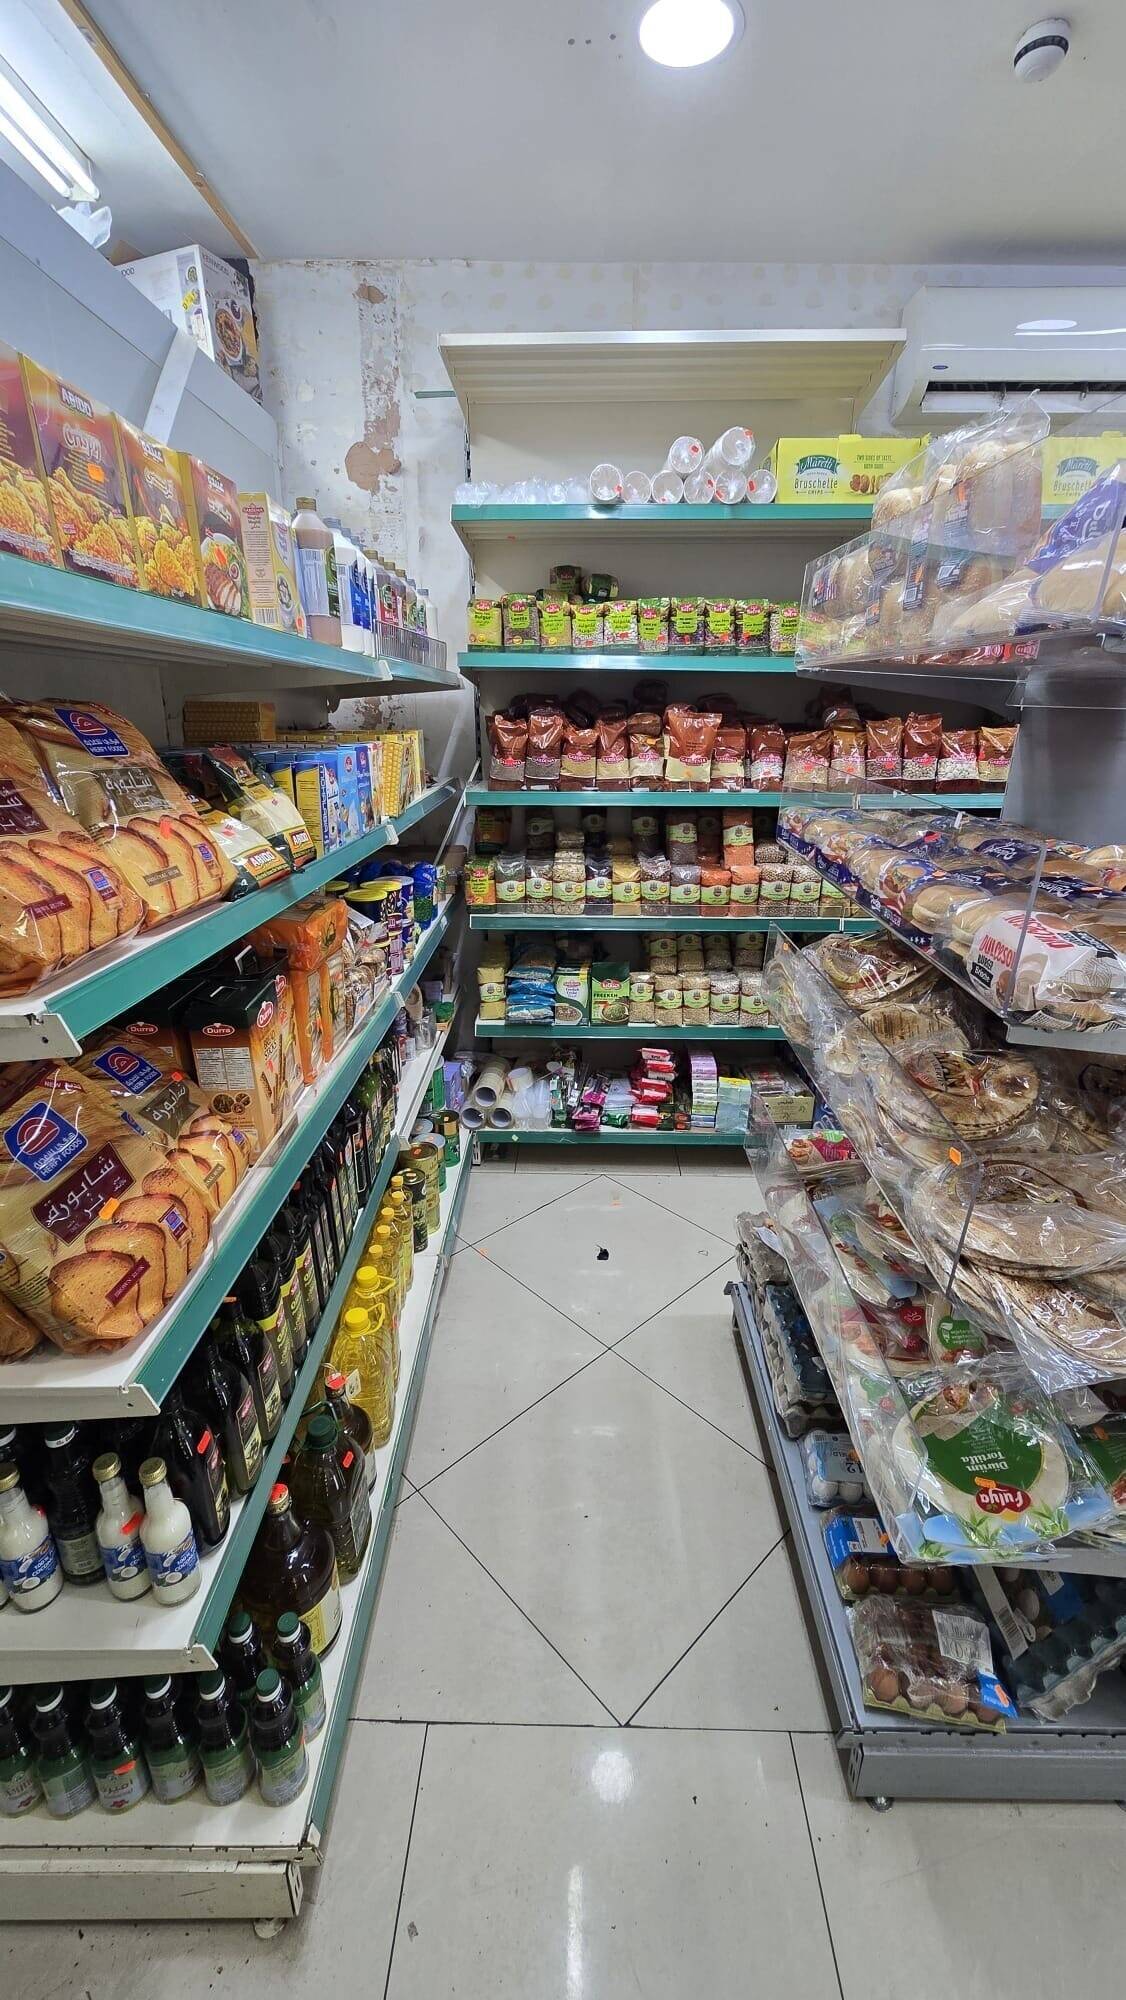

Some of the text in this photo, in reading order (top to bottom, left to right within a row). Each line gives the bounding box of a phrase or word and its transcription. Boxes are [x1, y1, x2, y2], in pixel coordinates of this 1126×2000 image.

[41, 1137, 83, 1177] HERFY FOODS
[960, 1451, 1006, 1464] Tortilla
[966, 1460, 1009, 1473] Dürüm
[979, 1486, 1024, 1507] Fulya
